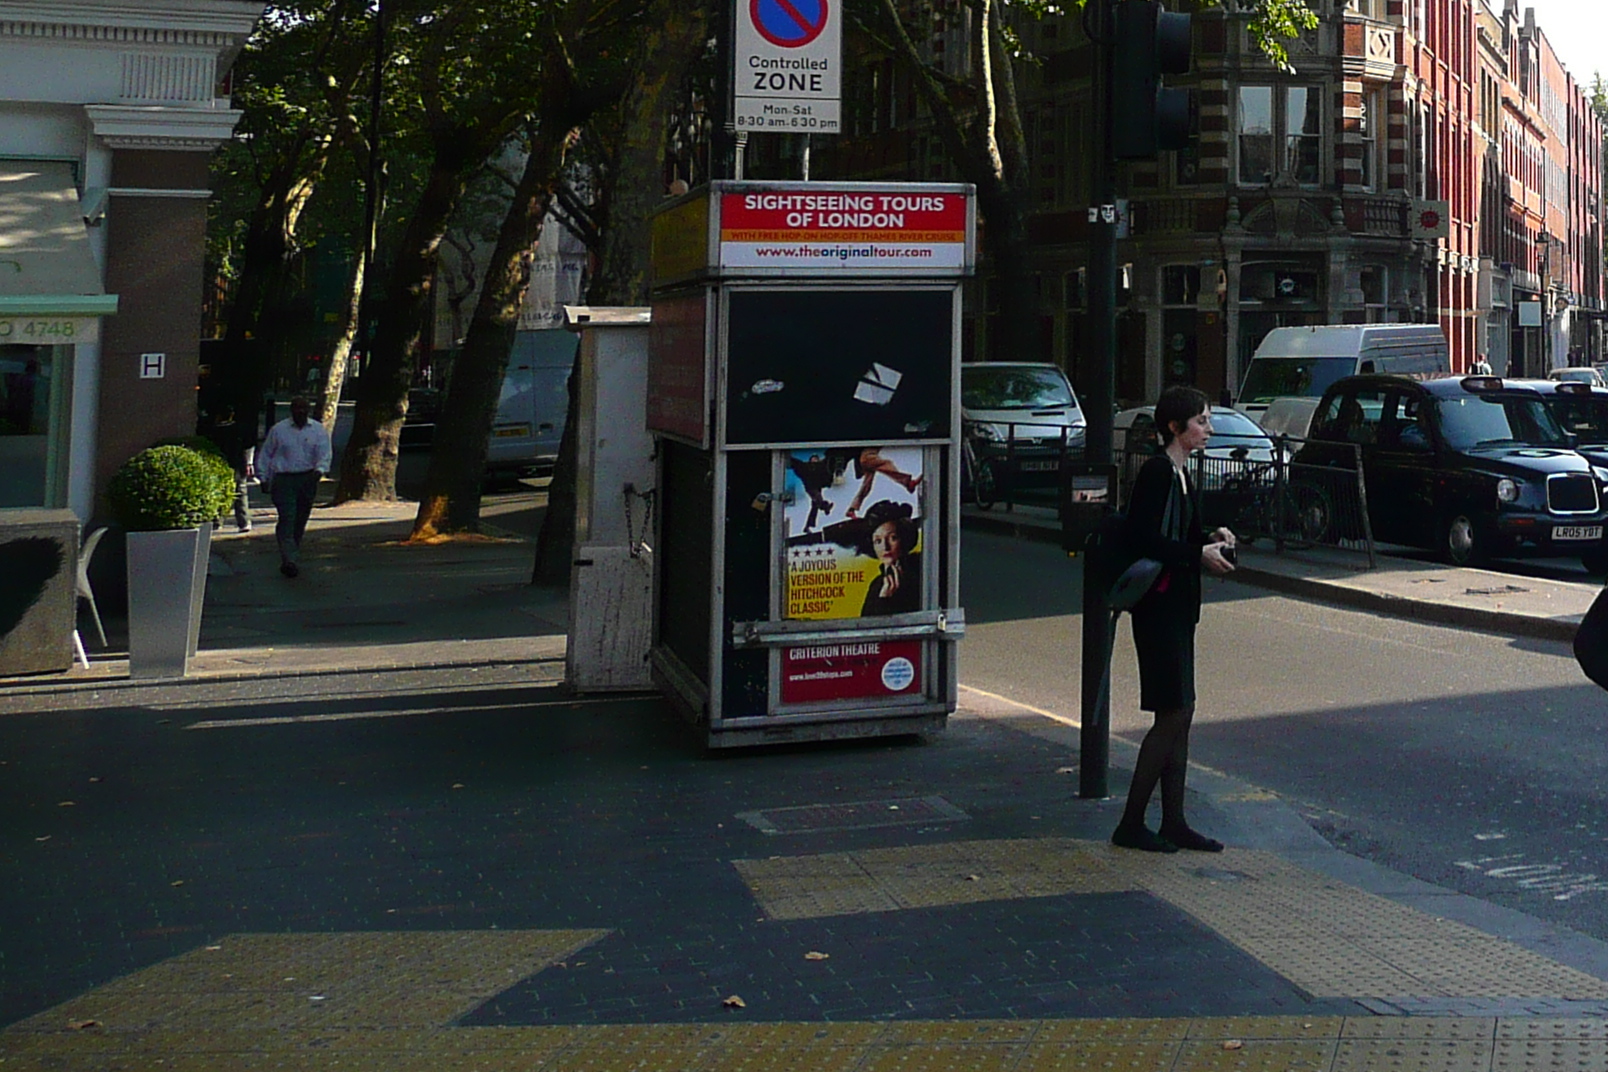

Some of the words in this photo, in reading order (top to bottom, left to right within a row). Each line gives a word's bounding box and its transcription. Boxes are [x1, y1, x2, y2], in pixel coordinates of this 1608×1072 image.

[749, 55, 828, 70] Controlled
[753, 72, 823, 92] ZONE
[820, 119, 838, 129] pm
[744, 195, 874, 211] SIGHTSEEING
[878, 196, 945, 212] TOURS
[786, 212, 814, 228] OF
[818, 212, 904, 229] LONDON
[731, 231, 756, 241] WITH
[758, 231, 779, 241] FREE
[861, 231, 897, 241] THAMES
[899, 232, 924, 241] RIVER
[925, 232, 956, 241] CRUISE
[756, 244, 933, 261] www.theoriginaltour.com
[23, 320, 75, 337] 4748
[144, 355, 162, 376] H
[799, 558, 837, 572] JOYOUS
[791, 572, 832, 587] VERSION
[833, 571, 846, 584] OF
[847, 570, 865, 583] THE
[791, 586, 846, 601] HITCHCOCK
[789, 645, 839, 660] CRITERION
[841, 642, 880, 656] THEATRE
